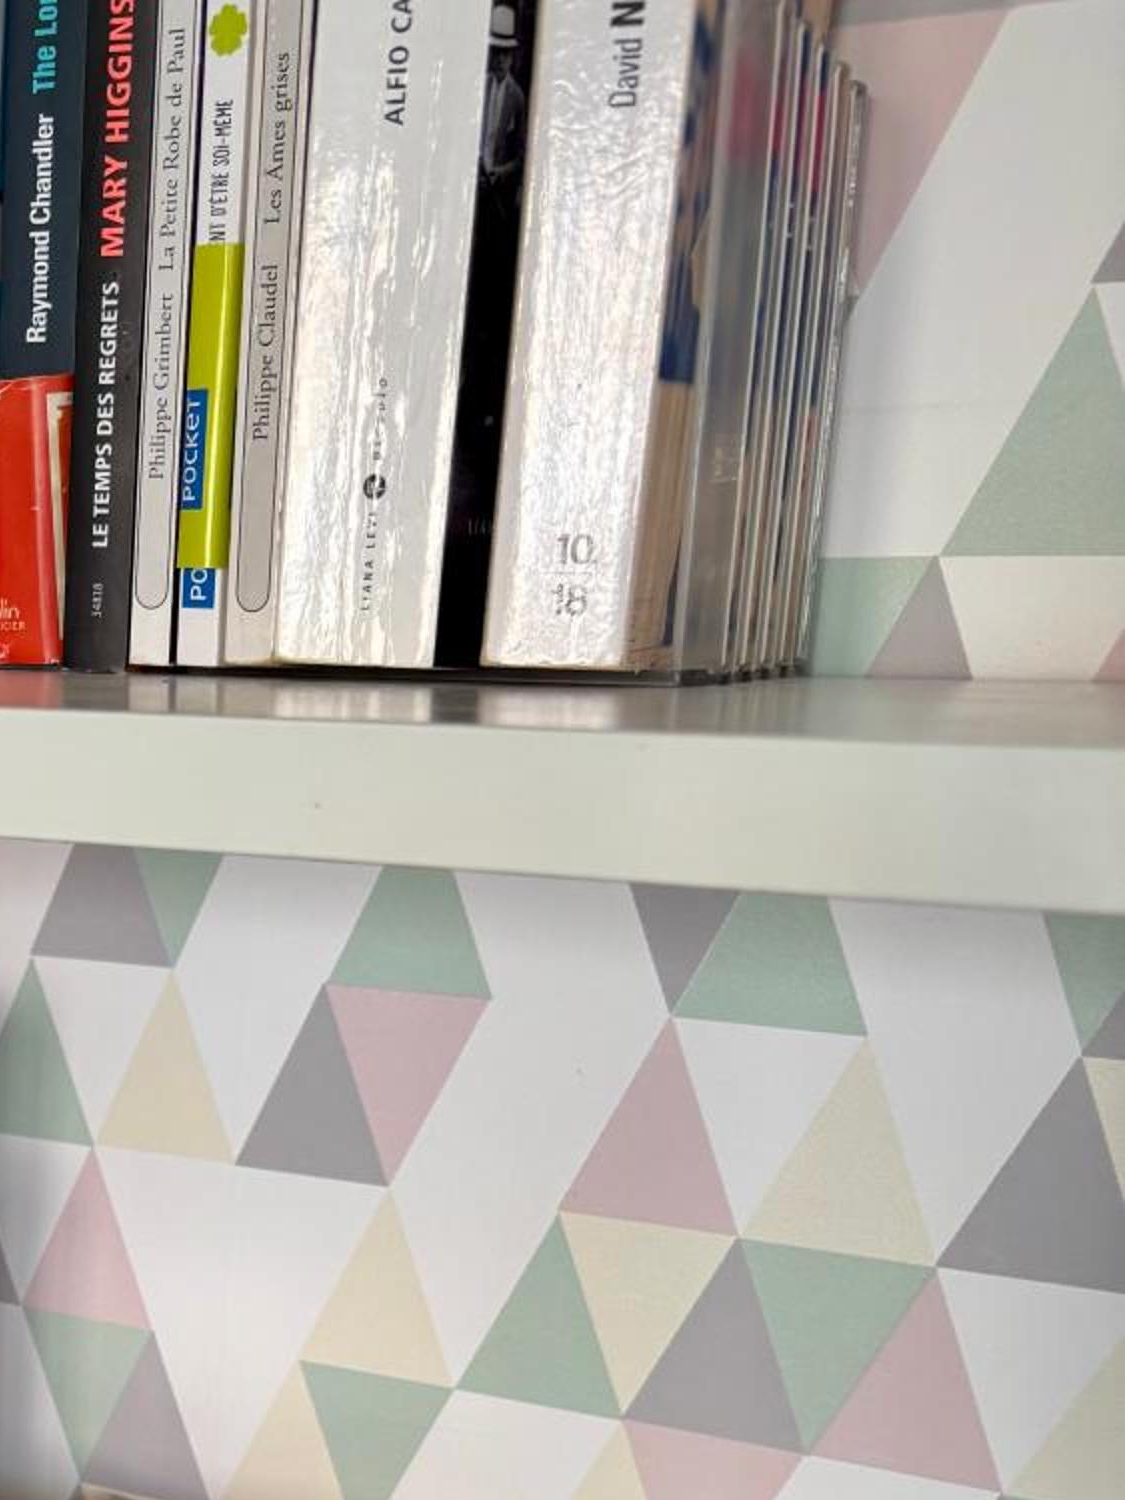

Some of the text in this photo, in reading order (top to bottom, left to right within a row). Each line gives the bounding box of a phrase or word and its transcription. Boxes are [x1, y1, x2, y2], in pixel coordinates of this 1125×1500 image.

[26, 45, 58, 344] Raymond Chandler The
[383, 43, 410, 126] ALFIO
[607, 38, 643, 108] David
[92, 0, 135, 549] LE TEMPS DES REGRETS MARY HIGGINS
[148, 28, 185, 480] Philippe Grimbert La Petite Robe de Paul
[253, 53, 292, 441] Philippe Claudel Les grises
